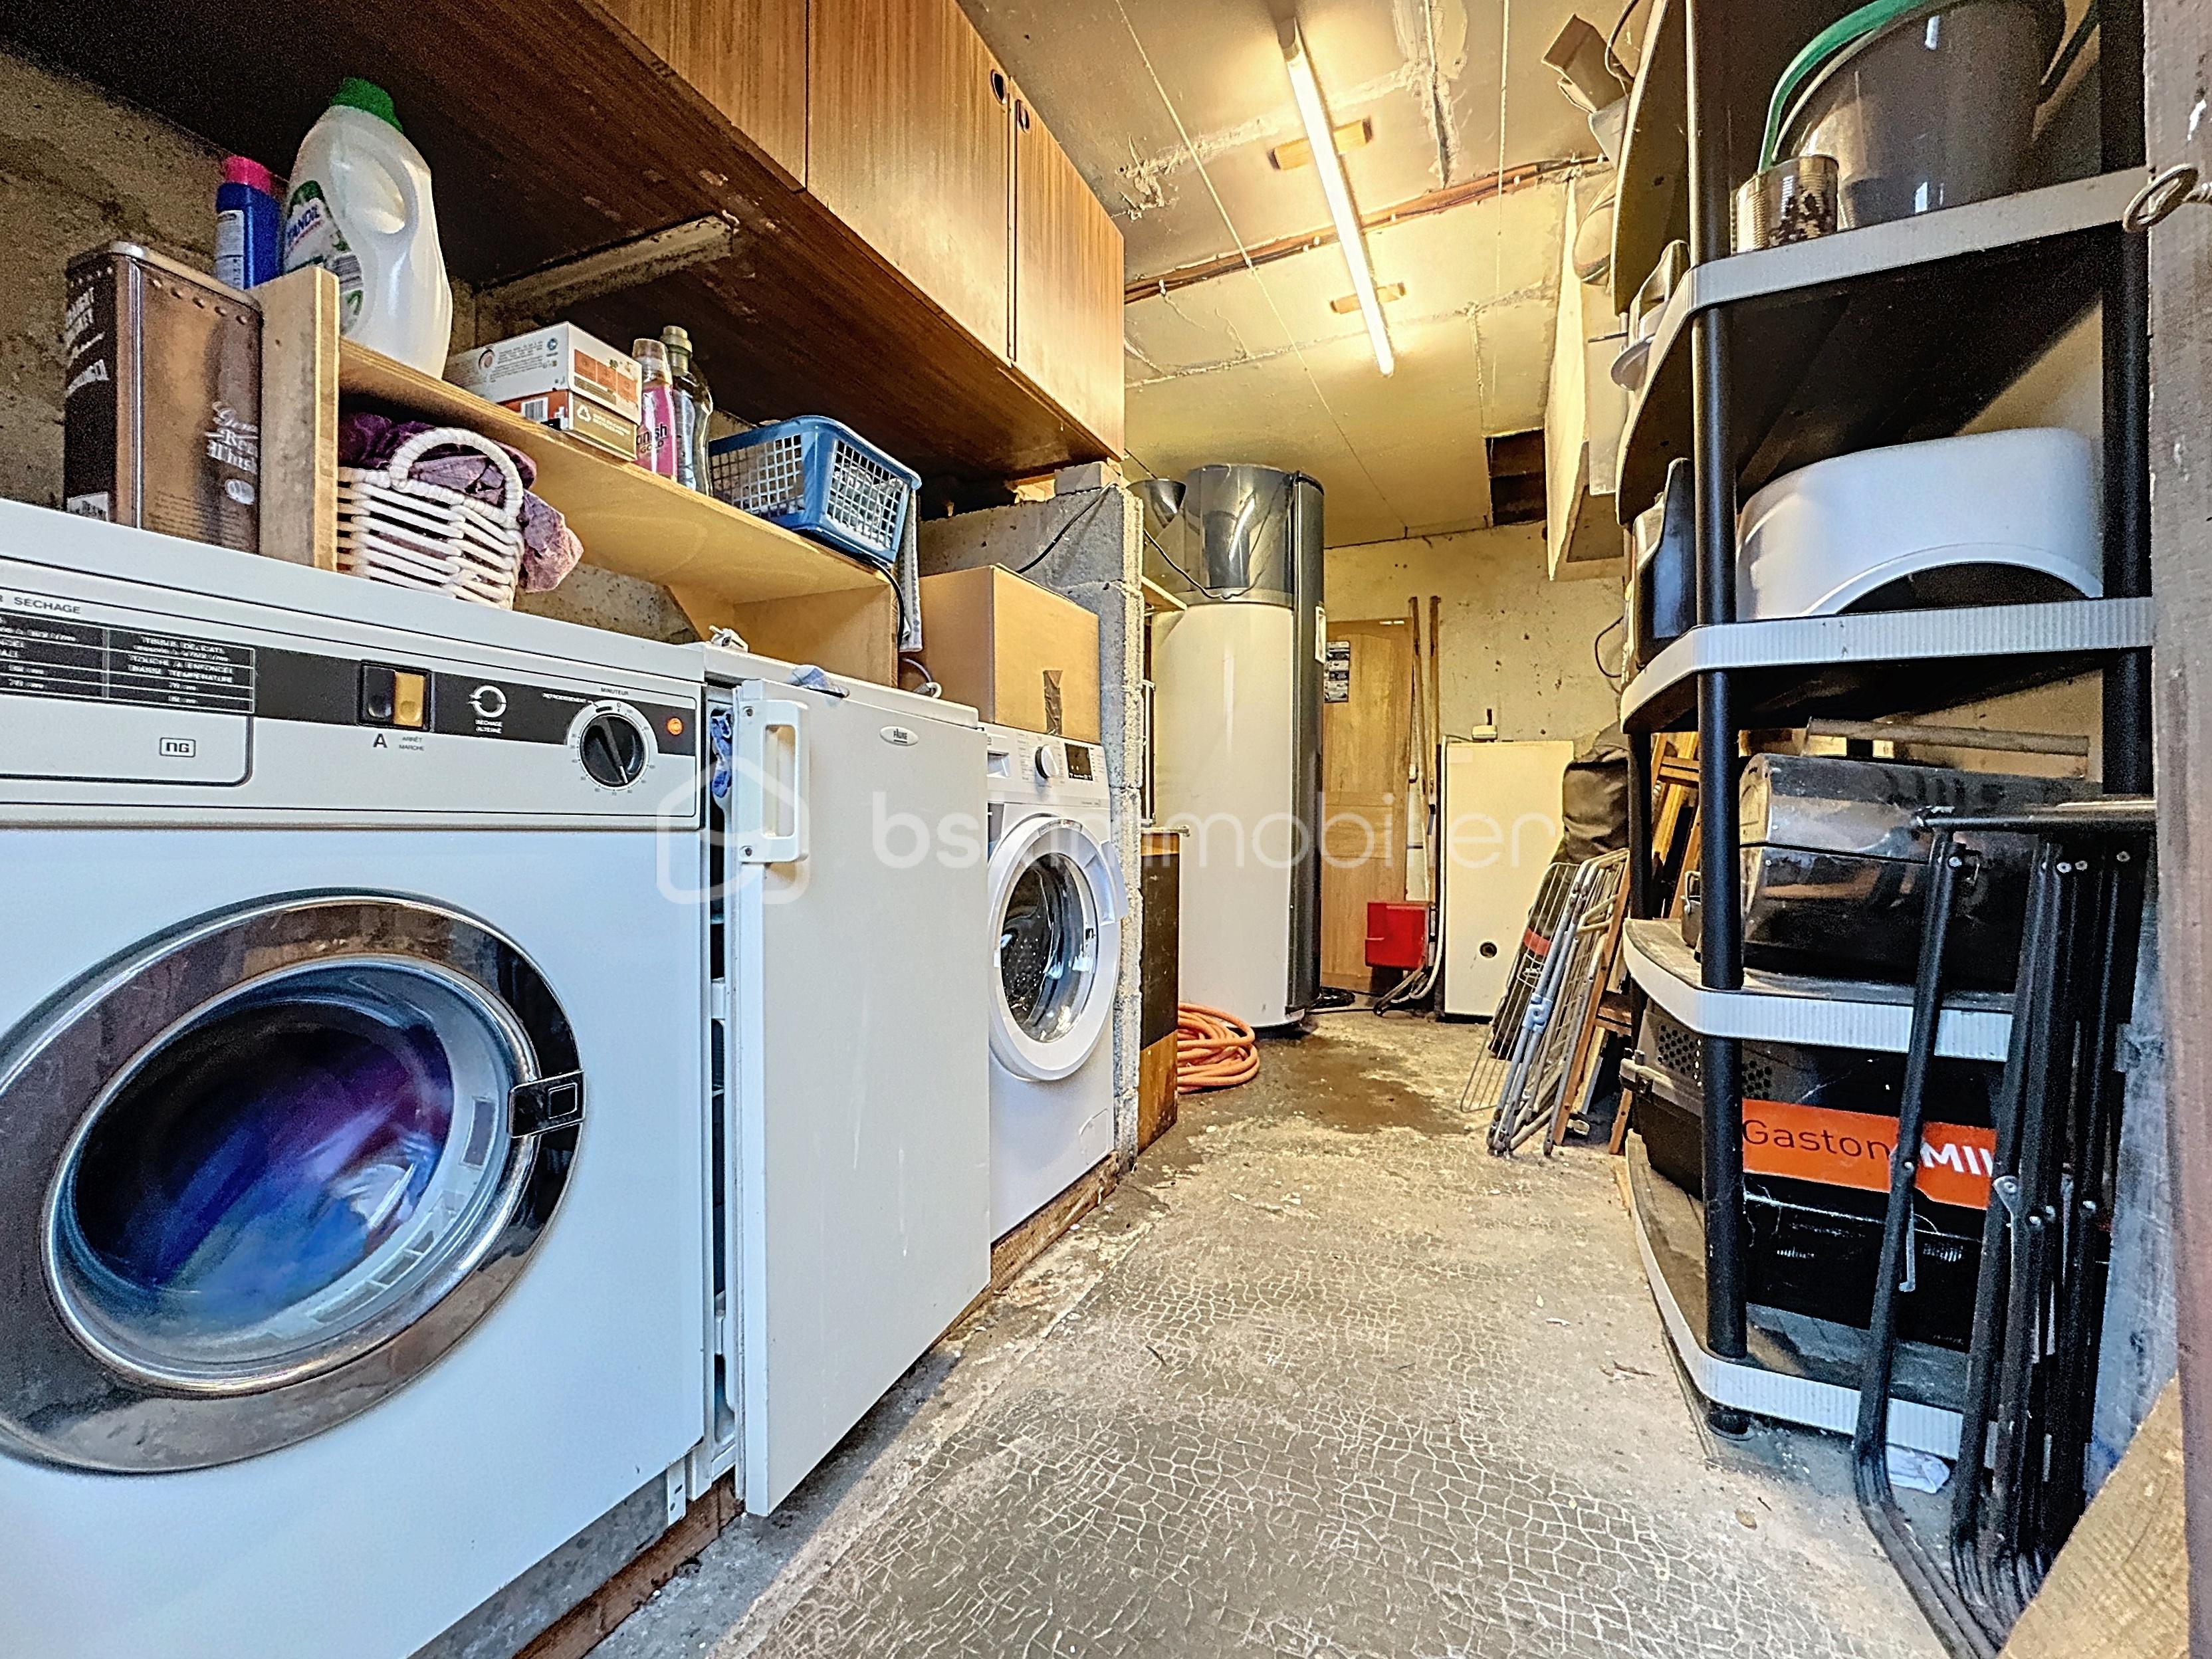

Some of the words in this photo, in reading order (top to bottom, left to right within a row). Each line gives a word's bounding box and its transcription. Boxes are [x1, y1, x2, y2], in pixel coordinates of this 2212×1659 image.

[14, 597, 81, 614] SECHAGE
[600, 687, 629, 696] MINUTEUR
[373, 733, 387, 748] A
[1742, 1119, 1890, 1160] Gaston
